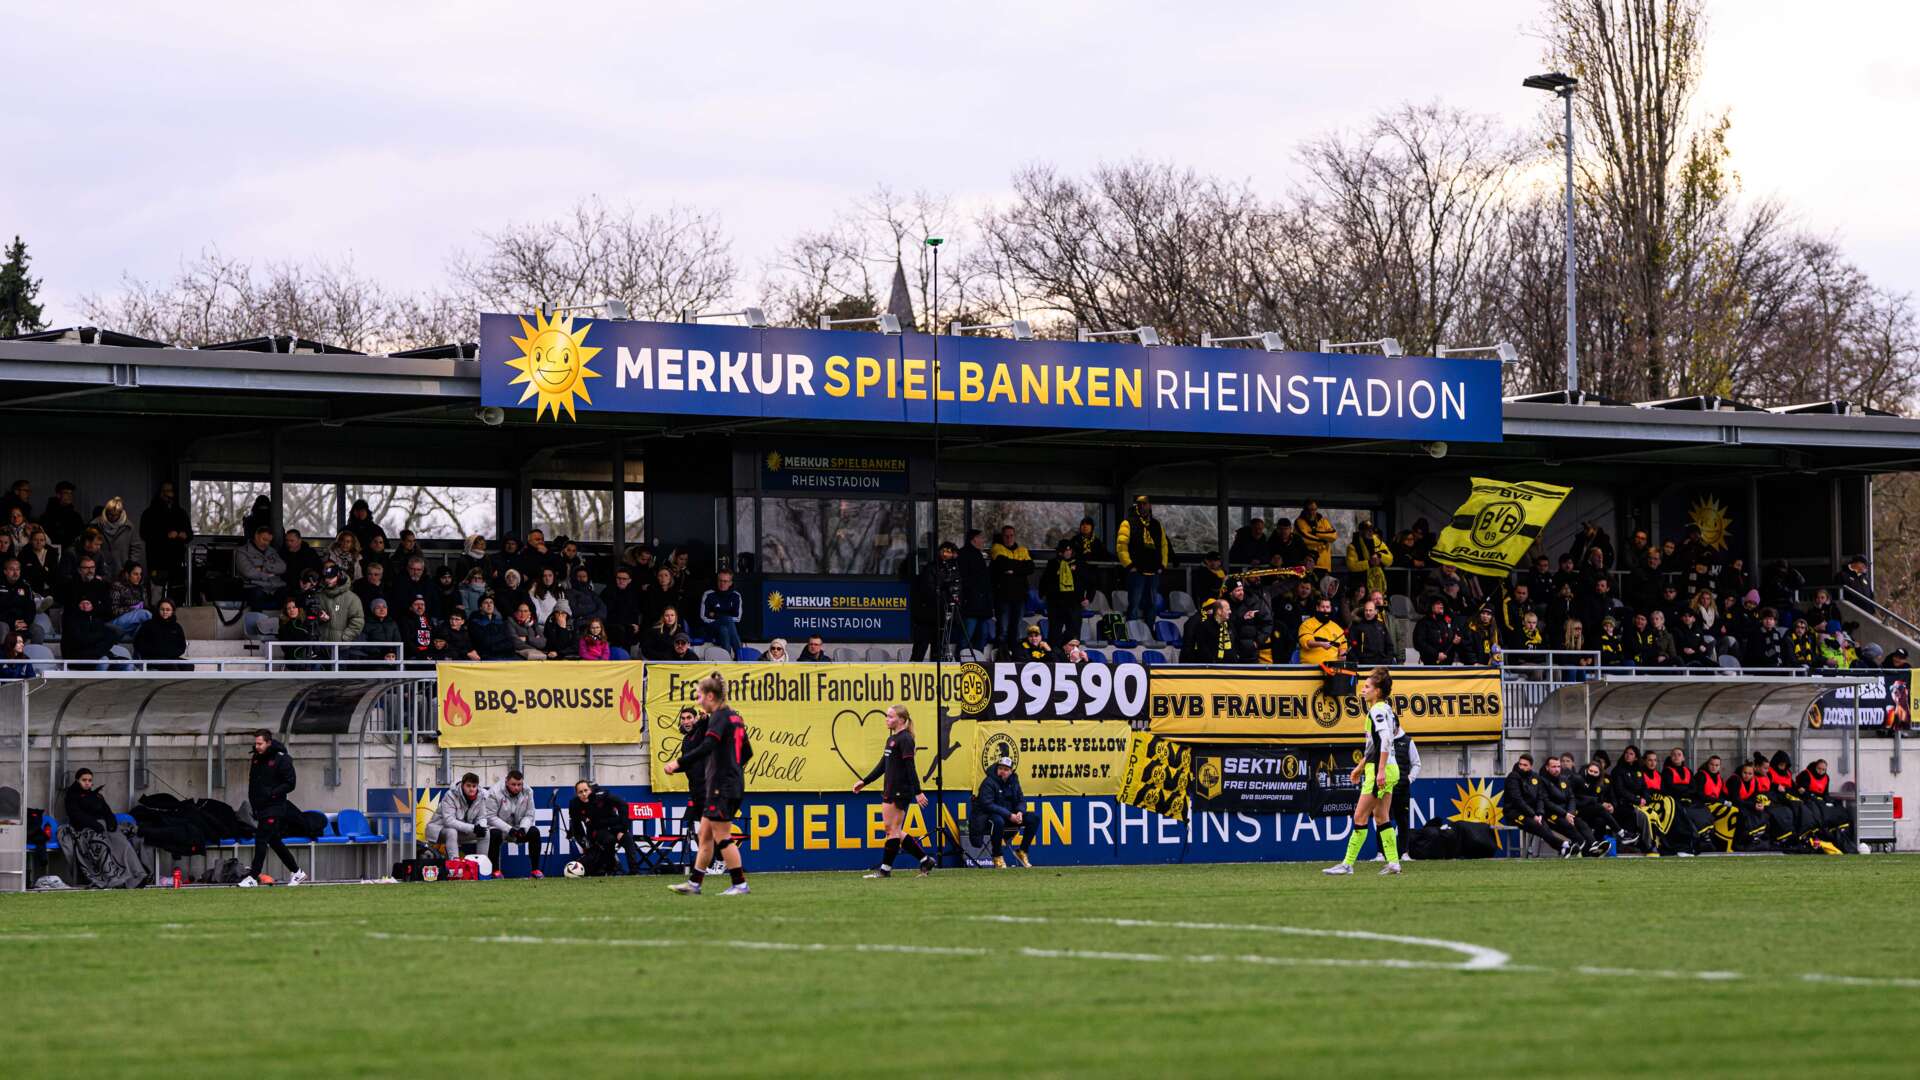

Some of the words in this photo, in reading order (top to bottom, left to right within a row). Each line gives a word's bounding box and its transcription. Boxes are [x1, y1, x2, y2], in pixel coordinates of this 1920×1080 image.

[615, 346, 815, 397] MERKUR
[823, 355, 1143, 409] SPIELBANKEN
[1156, 369, 1466, 420] RHEINSTADION
[784, 456, 829, 468] MERKUR
[831, 458, 905, 470] SPIELBANKEN
[792, 475, 880, 488] RHEINSTADION
[1499, 487, 1534, 501] BVB
[1450, 546, 1508, 561] FRAUEN
[786, 596, 831, 607] MERKUR
[832, 597, 907, 608] SPIELBANKEN
[793, 617, 882, 629] RHEINSTADION
[668, 672, 811, 702] Franfußball
[817, 672, 895, 702] Fanclub
[900, 673, 936, 702] BVB
[941, 673, 962, 702] 09
[994, 662, 1148, 717] 59590
[474, 687, 614, 714] BBQ-BORUSSE
[1150, 694, 1205, 718] BVB
[1211, 694, 1309, 719] FRAUEN
[1344, 693, 1501, 717] SPORTERS
[1822, 707, 1885, 726] DORTUND
[769, 725, 812, 747] und
[1020, 737, 1127, 752] BLACK-YELLOW
[1031, 764, 1091, 779] INDIANS
[1223, 754, 1308, 779] SEKTION
[1223, 780, 1248, 790] FREI
[1248, 781, 1308, 791] SCHWIMMER
[729, 800, 1072, 851] PIELBANN
[1088, 797, 1436, 845] RHEINSTADN
